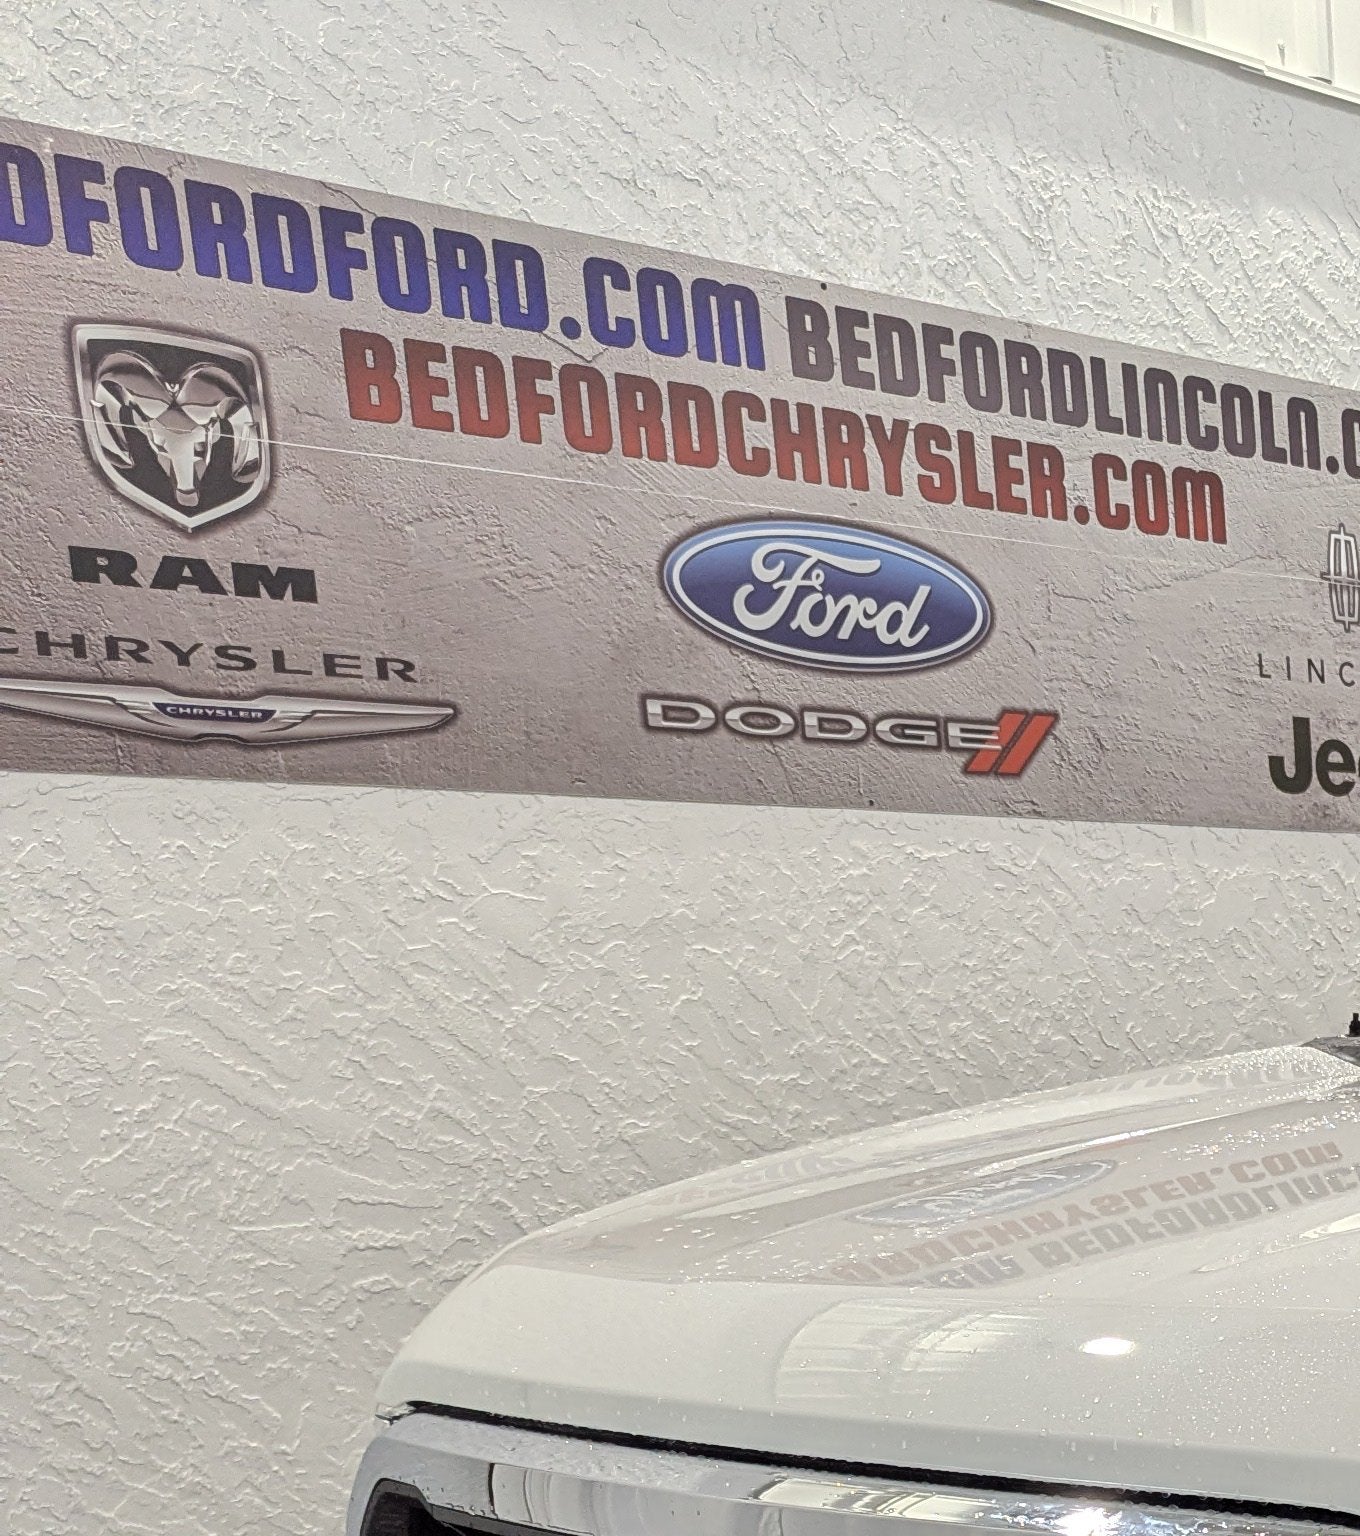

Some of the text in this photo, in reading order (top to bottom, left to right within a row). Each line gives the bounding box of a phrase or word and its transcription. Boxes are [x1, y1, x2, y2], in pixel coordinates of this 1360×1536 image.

[340, 327, 1228, 544] BEDFORDCHRYSLER.COM
[67, 545, 319, 604] RAM
[732, 541, 932, 647] Ford
[166, 705, 264, 720] CHRYSLER
[645, 696, 1002, 752] DODGE
